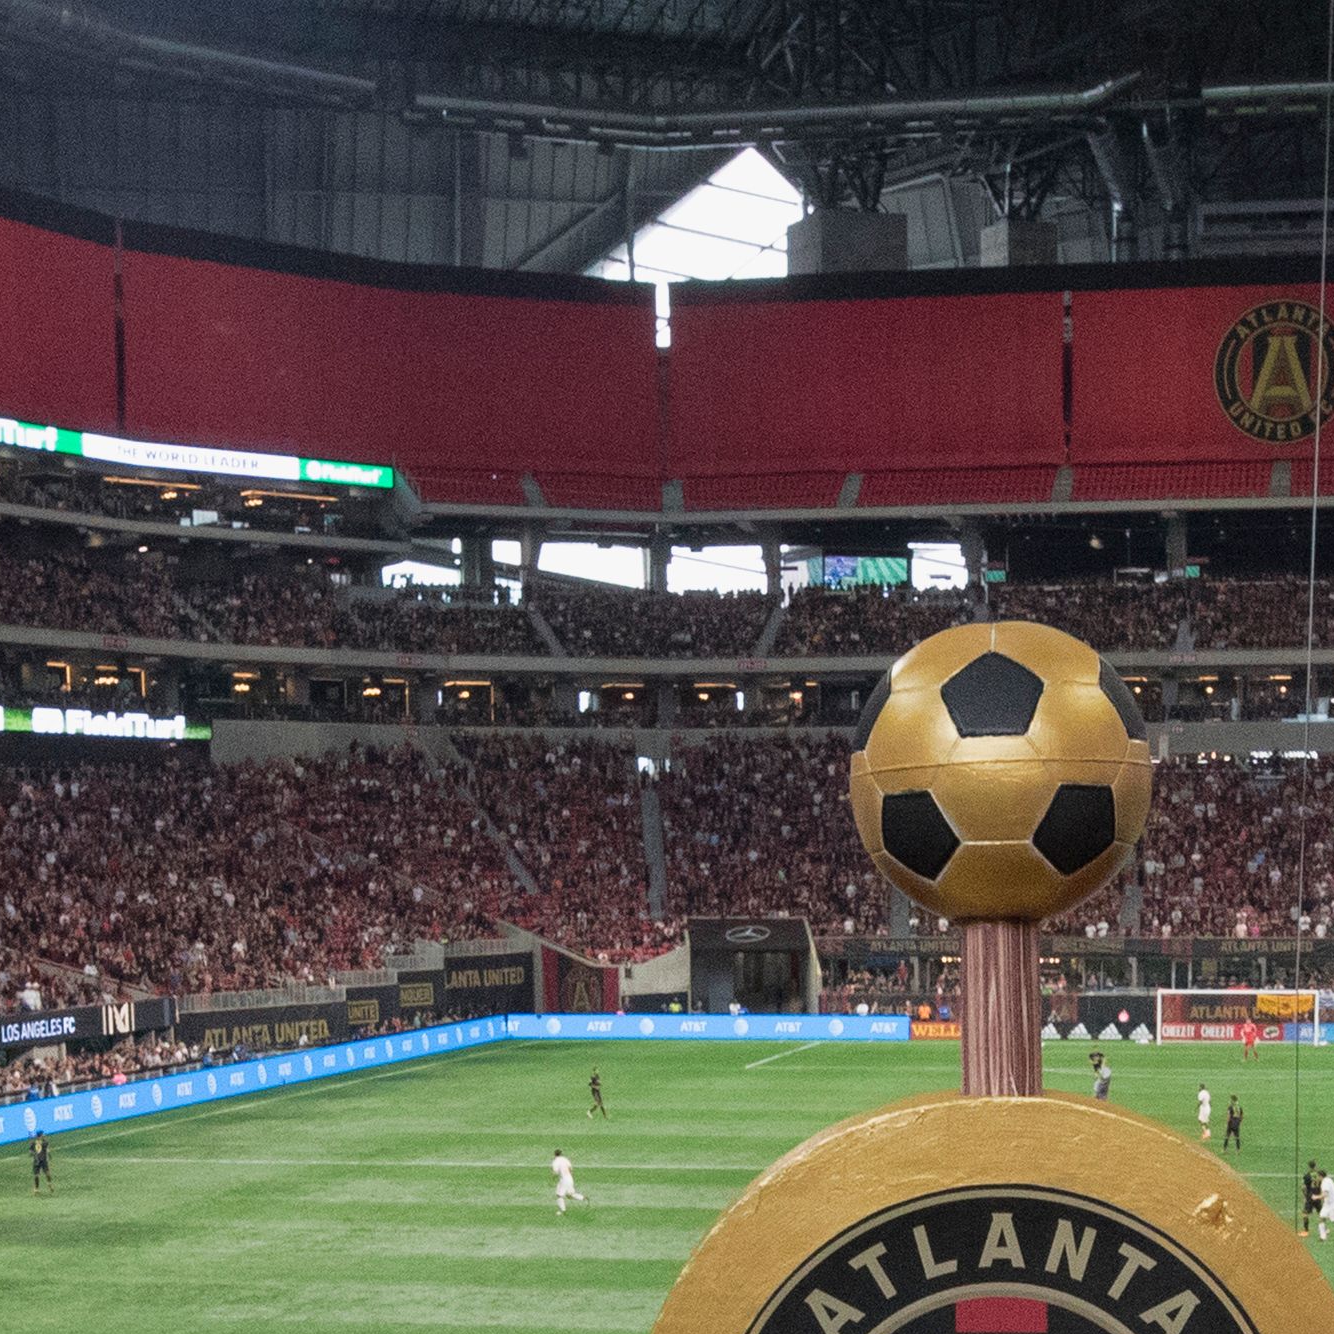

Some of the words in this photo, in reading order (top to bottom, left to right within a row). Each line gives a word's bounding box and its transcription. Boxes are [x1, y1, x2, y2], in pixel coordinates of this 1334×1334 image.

[1, 1024, 20, 1043] LOS
[21, 1018, 62, 1041] ANGELES
[62, 1016, 76, 1035] FC
[870, 1021, 898, 1034] AT&T
